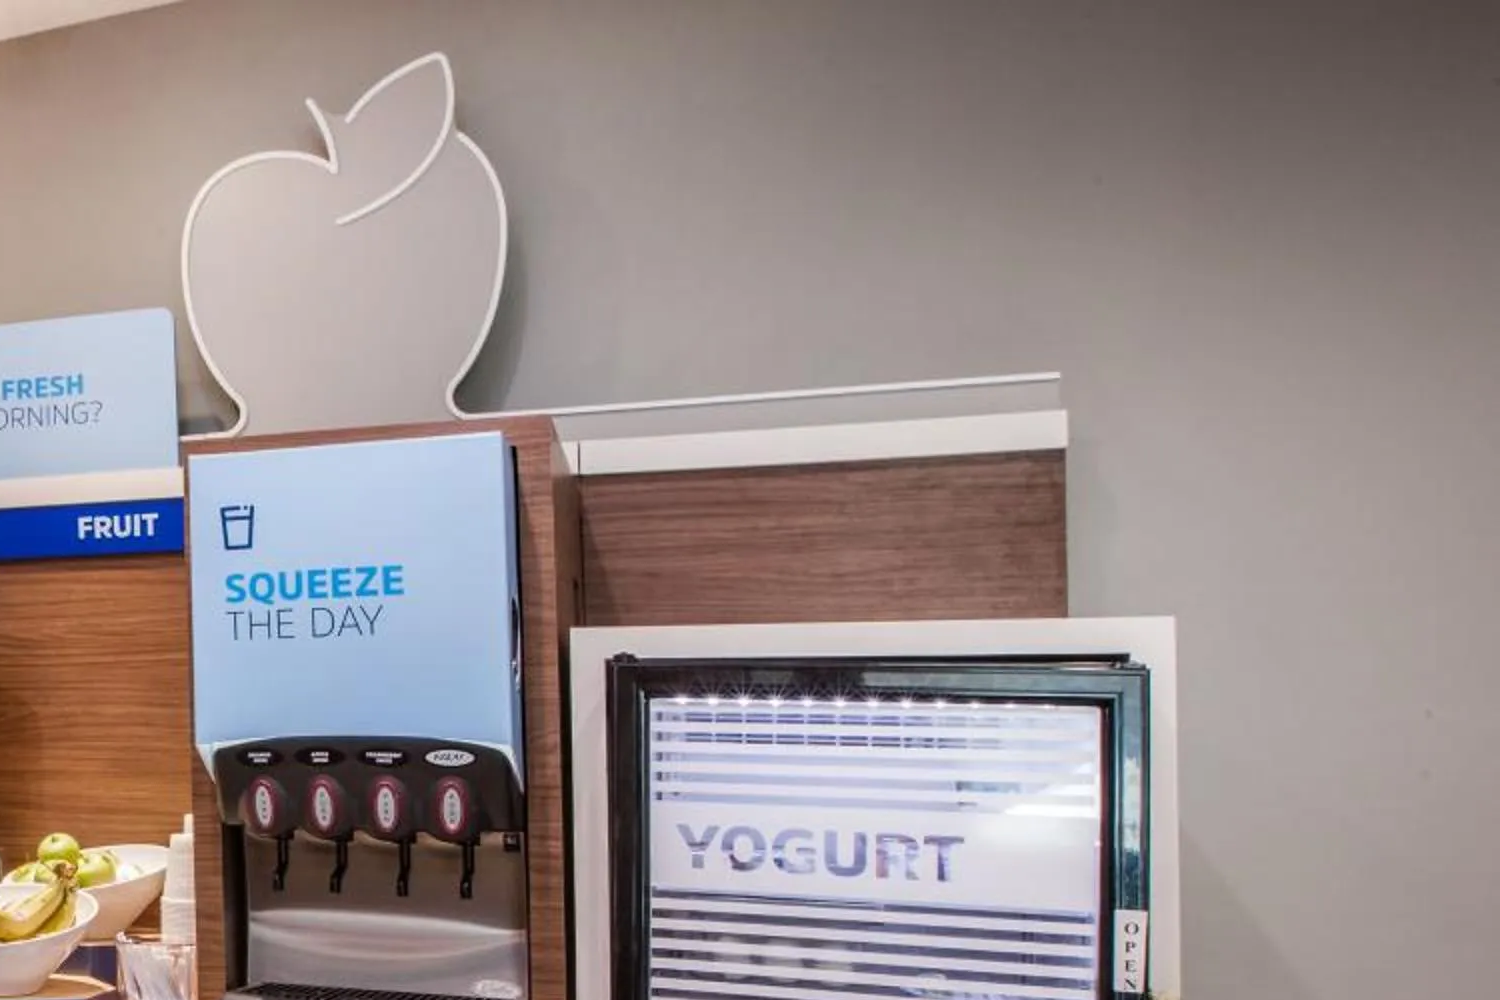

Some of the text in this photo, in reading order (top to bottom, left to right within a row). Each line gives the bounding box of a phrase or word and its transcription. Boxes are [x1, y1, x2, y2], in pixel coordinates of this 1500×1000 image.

[1, 373, 84, 402] FRESH
[76, 512, 160, 541] FRUIT
[225, 565, 405, 606] SQUEEZE
[227, 604, 384, 641] THE DAY
[676, 823, 966, 883] YOGURT
[1123, 921, 1140, 991] OPEN
